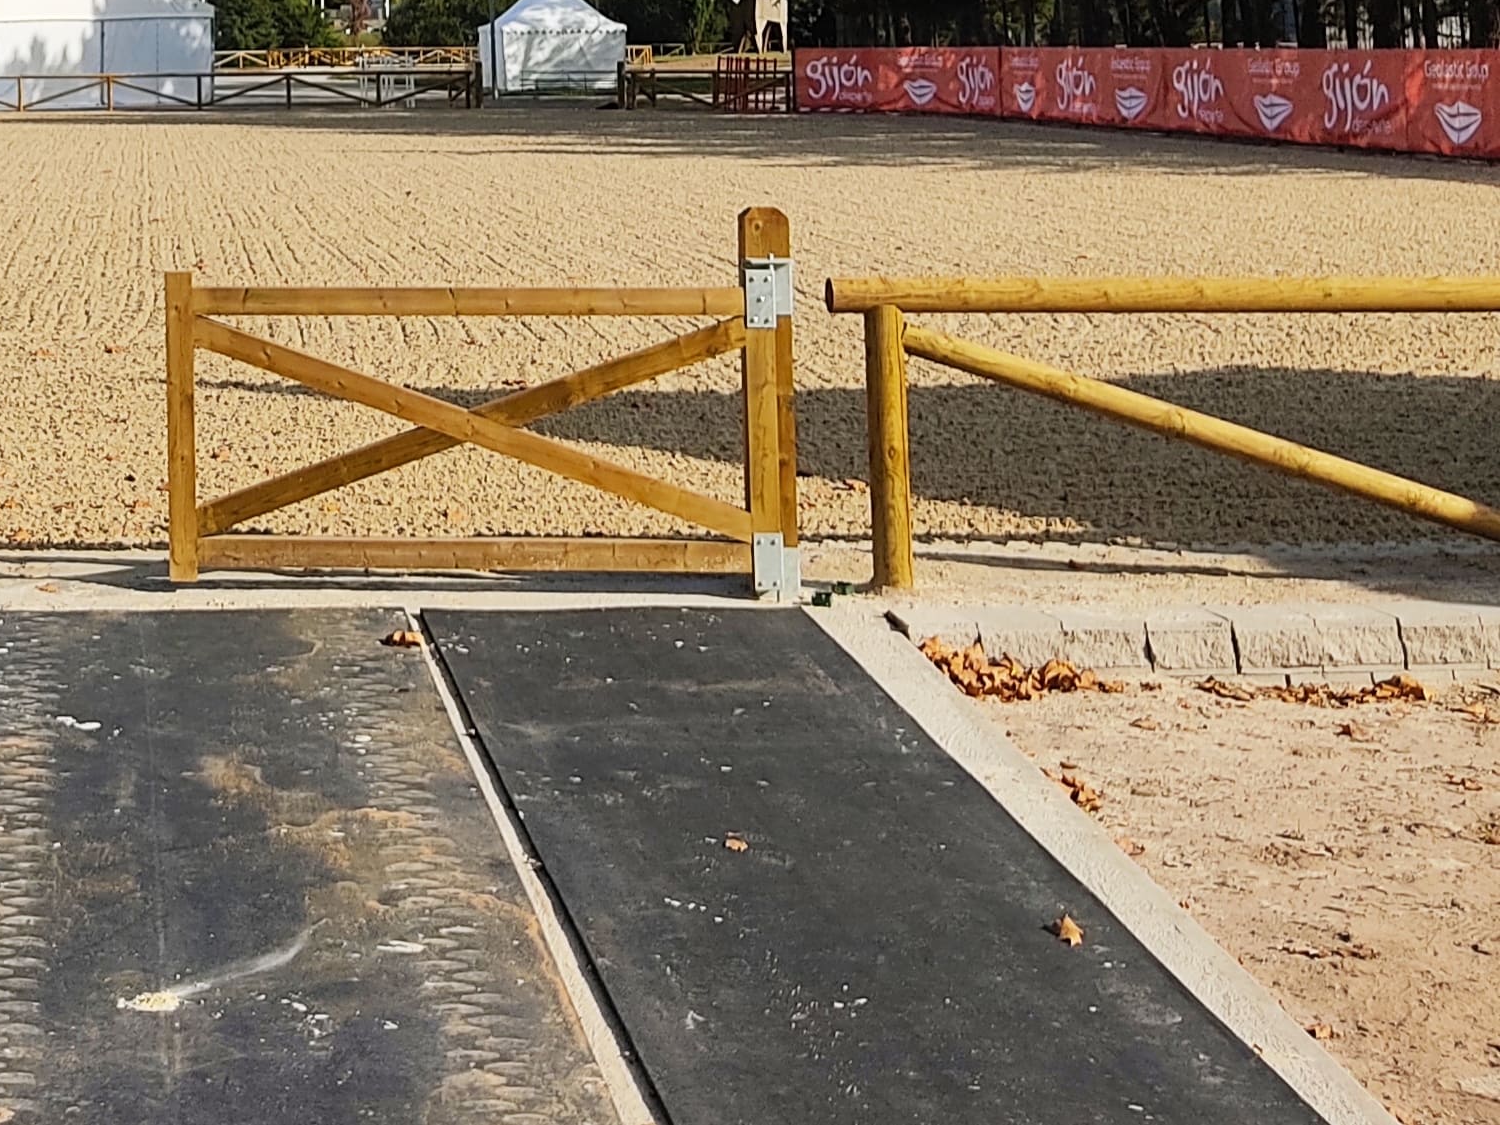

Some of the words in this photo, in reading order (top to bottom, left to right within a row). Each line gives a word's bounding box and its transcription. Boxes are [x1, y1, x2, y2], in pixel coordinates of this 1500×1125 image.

[806, 54, 872, 101] gijón
[957, 55, 994, 106] gijón
[1056, 55, 1097, 111] gijón
[1172, 57, 1224, 119] gijón
[1322, 59, 1389, 132] gijón
